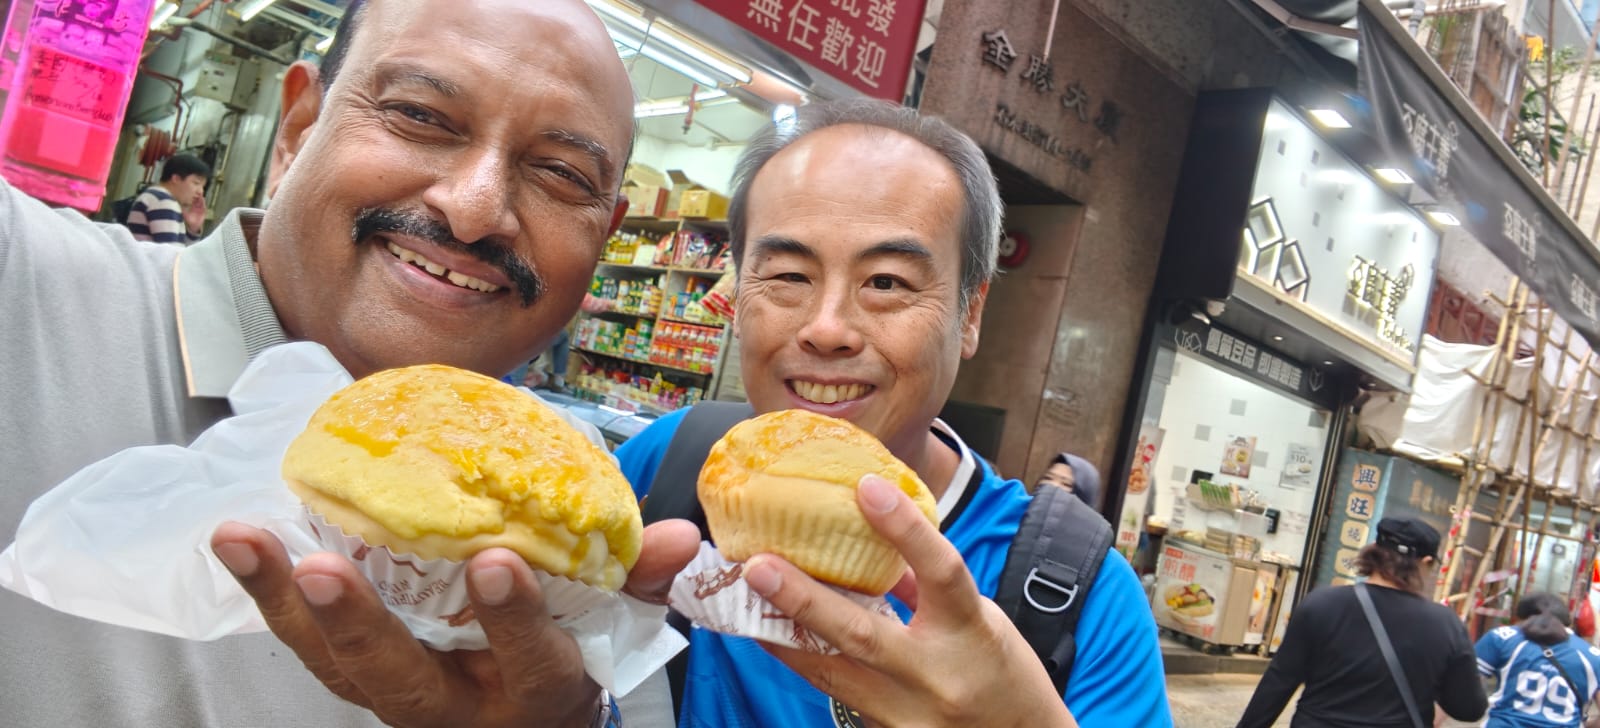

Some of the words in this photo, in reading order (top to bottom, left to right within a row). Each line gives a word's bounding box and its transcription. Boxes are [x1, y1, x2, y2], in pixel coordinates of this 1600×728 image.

[747, 0, 886, 88] 無任歡迎
[1513, 670, 1577, 723] 99
